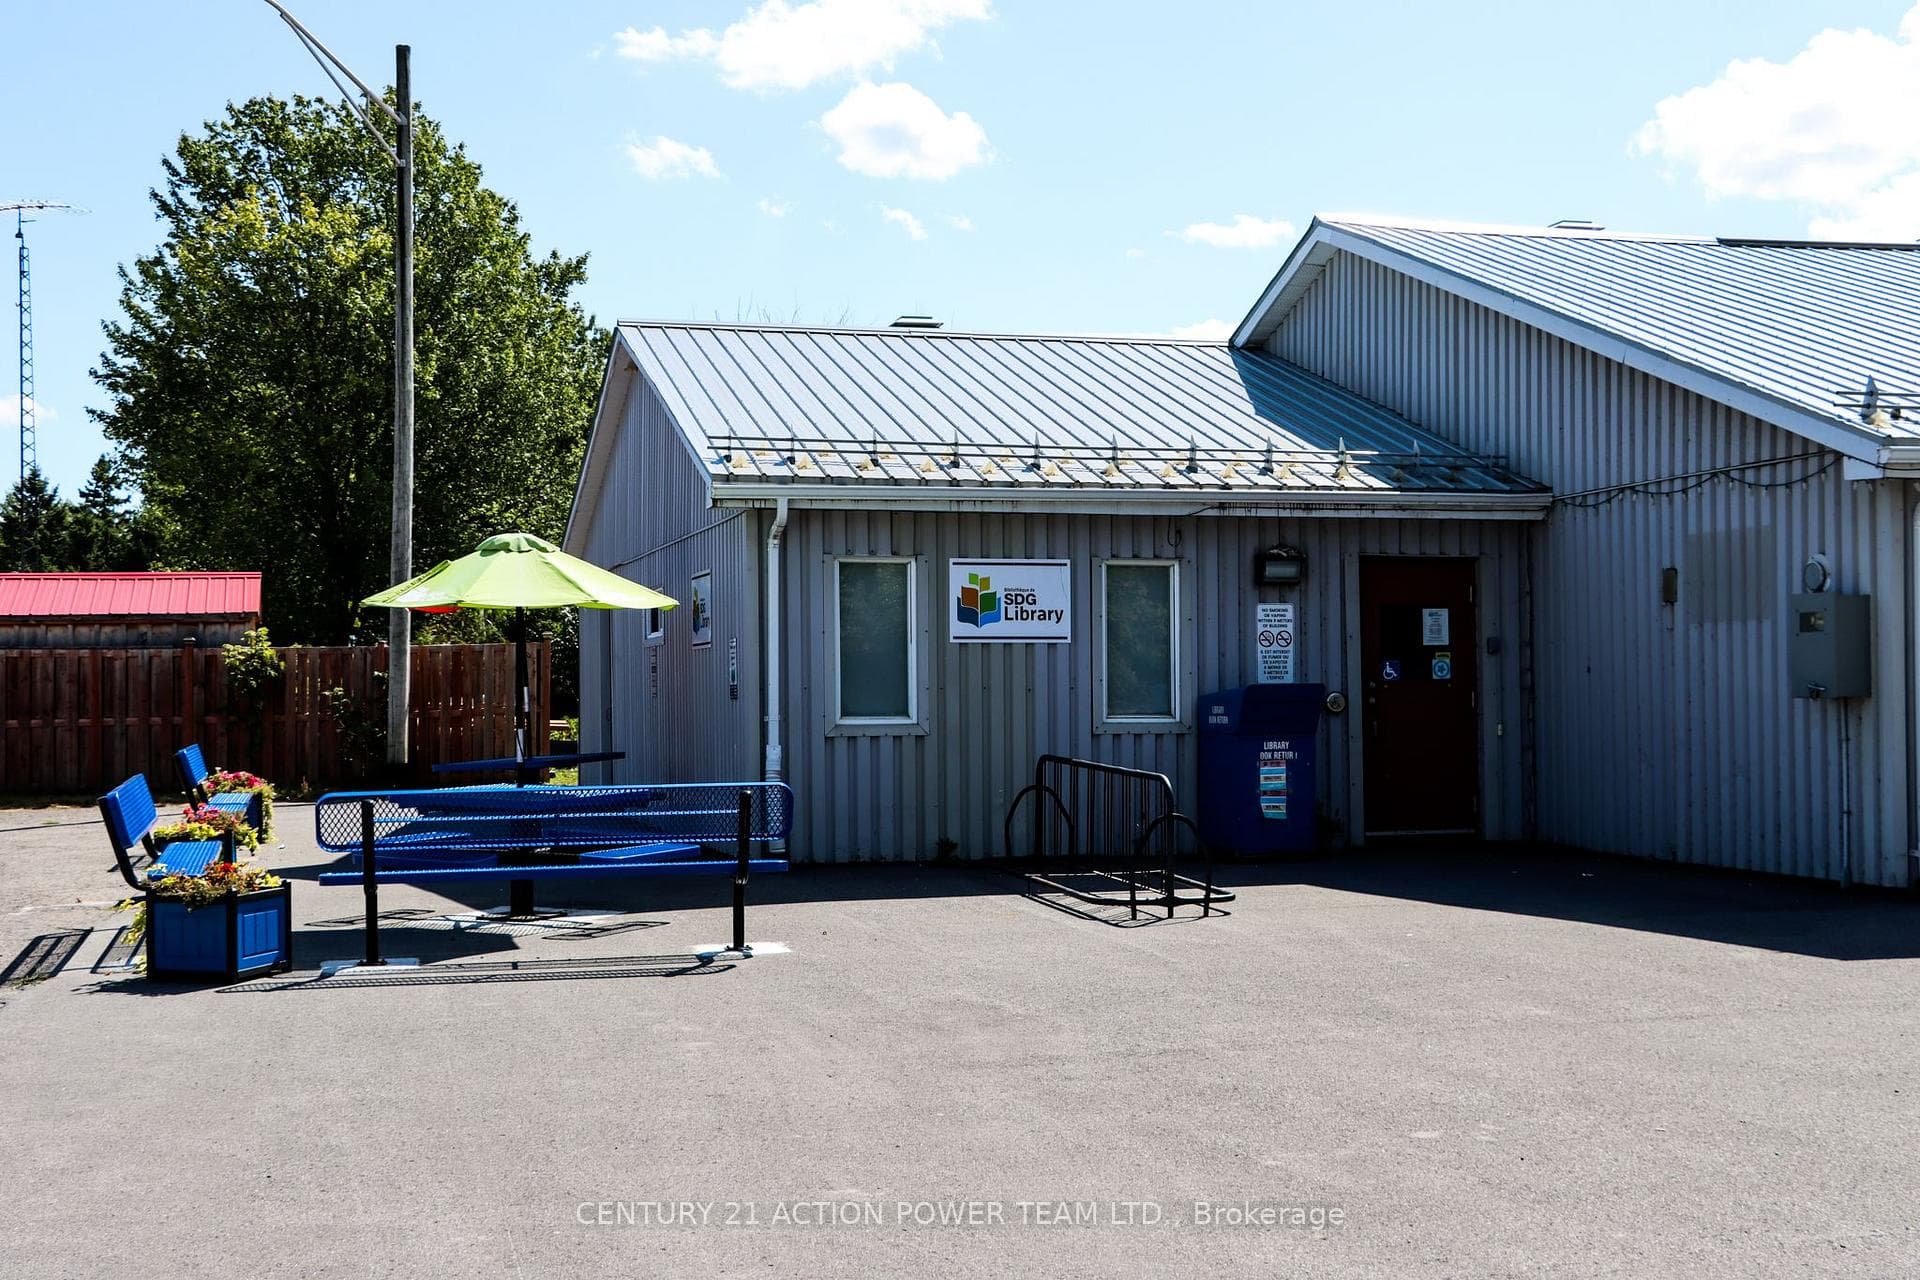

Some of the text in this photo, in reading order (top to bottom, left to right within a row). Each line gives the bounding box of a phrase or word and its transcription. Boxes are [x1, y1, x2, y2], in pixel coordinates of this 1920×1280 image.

[1004, 593, 1037, 605] SDG
[1004, 606, 1064, 624] Library
[1263, 741, 1289, 750] LIBRARY
